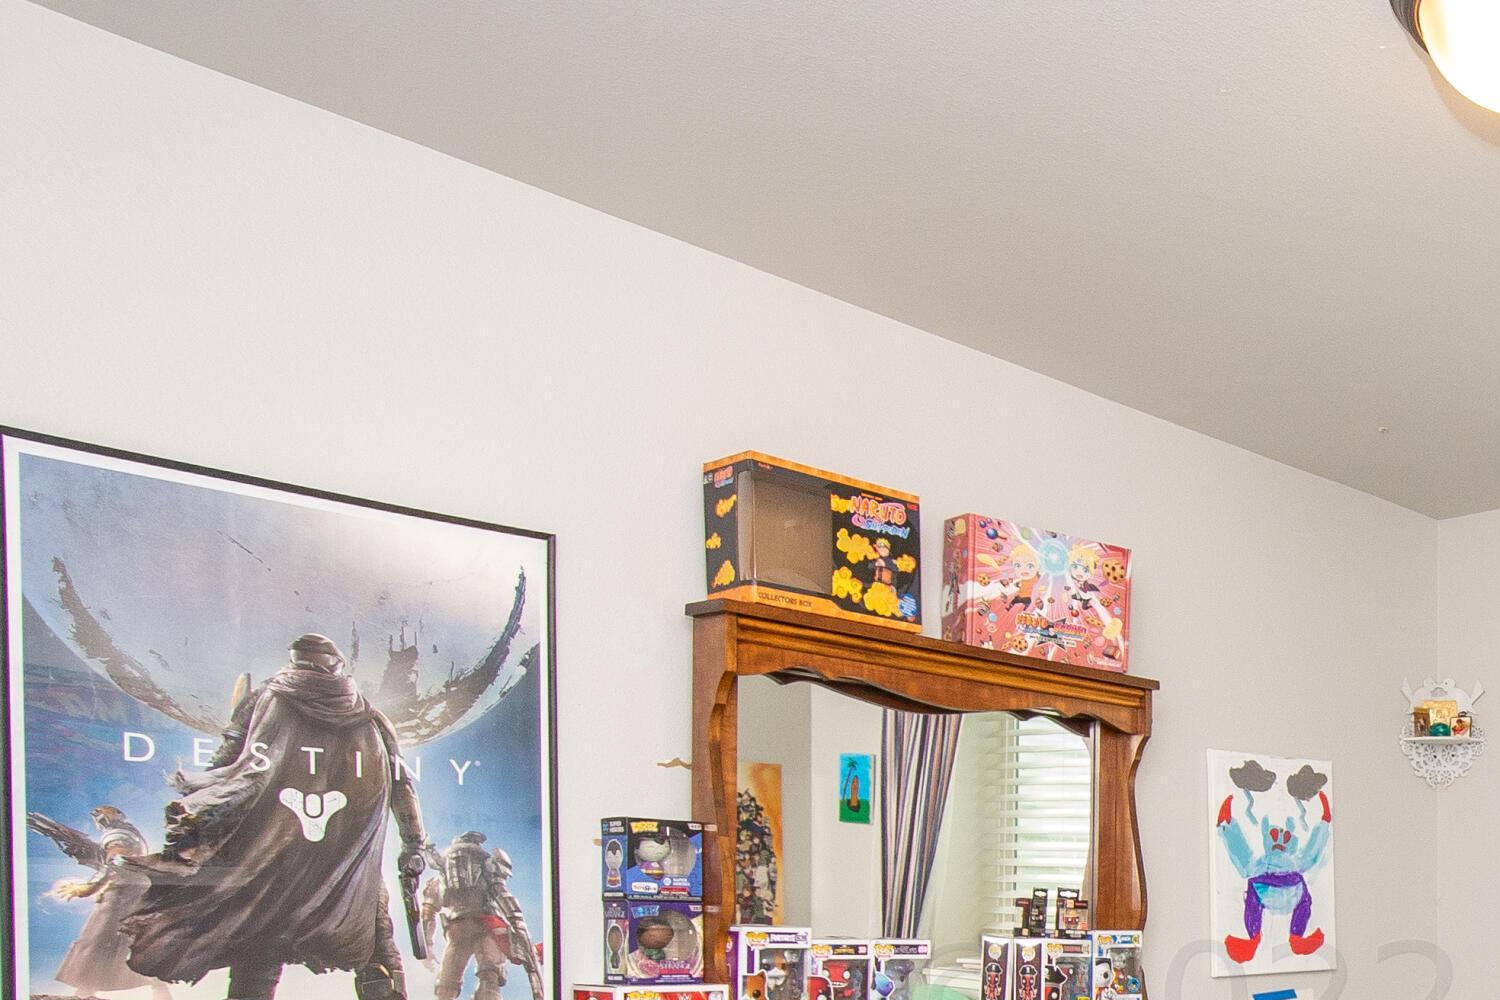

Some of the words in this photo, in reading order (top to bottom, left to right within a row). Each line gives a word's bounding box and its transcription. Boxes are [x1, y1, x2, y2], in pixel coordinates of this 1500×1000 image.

[850, 496, 907, 525] NARUTO
[758, 592, 798, 606] COLLECTORS
[799, 600, 812, 608] BOX
[123, 731, 472, 786] DESTINY
